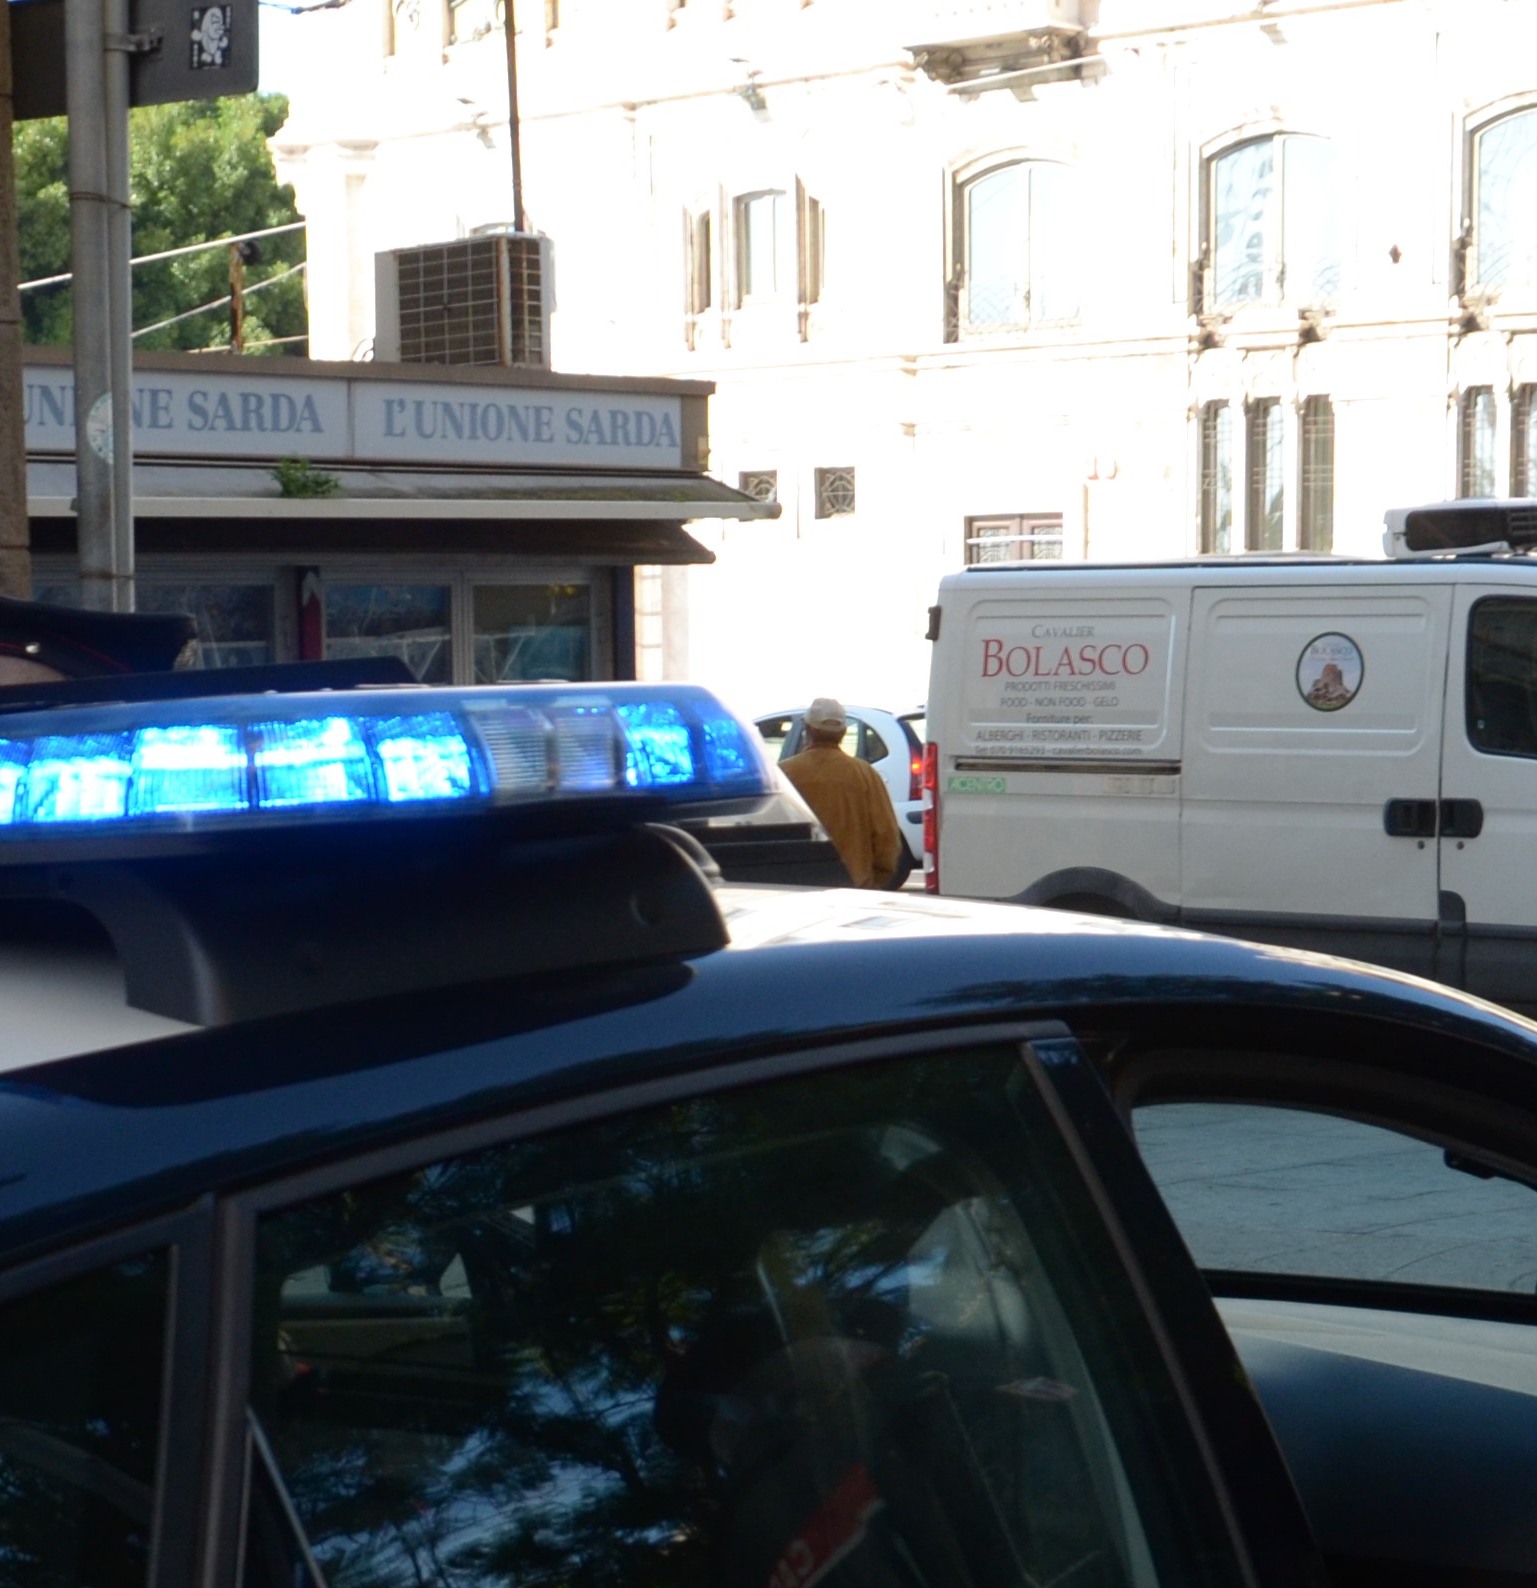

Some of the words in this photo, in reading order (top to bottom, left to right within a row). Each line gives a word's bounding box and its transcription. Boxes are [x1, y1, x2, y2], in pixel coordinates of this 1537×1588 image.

[187, 390, 324, 433] SARDA
[566, 408, 680, 447] SARDA
[981, 638, 1150, 678] BOLASCO
[1004, 681, 1050, 692] PRODOTTI
[1000, 697, 1028, 707] FOOD
[1034, 697, 1056, 707] NON
[1059, 697, 1086, 707] FOOD
[975, 730, 1024, 742] ALBERGHI
[1032, 729, 1090, 742] RISTORANTI
[1098, 730, 1142, 742] PIZZERIE
